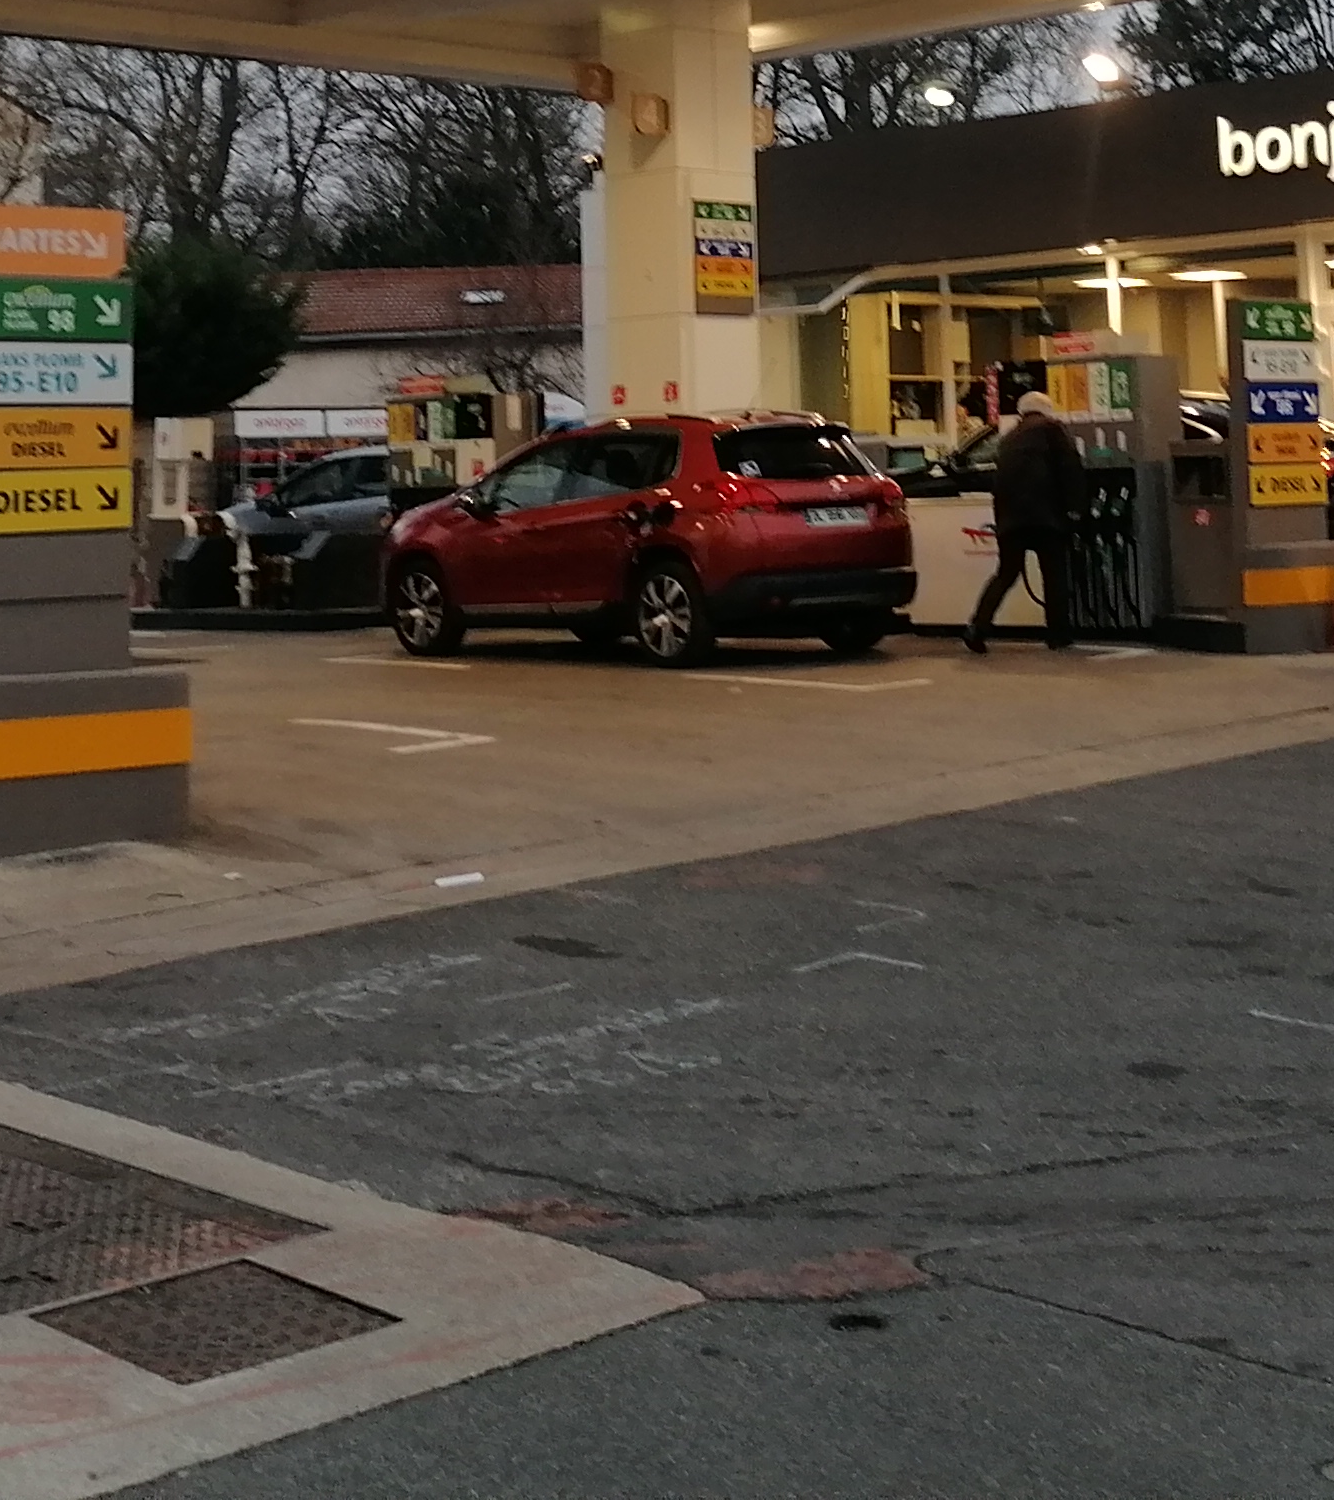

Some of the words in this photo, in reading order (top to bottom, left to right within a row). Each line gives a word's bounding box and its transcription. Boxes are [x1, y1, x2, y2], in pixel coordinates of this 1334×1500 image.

[47, 309, 76, 332] 98
[33, 353, 84, 368] PLOMB
[10, 441, 67, 458] DIESEL
